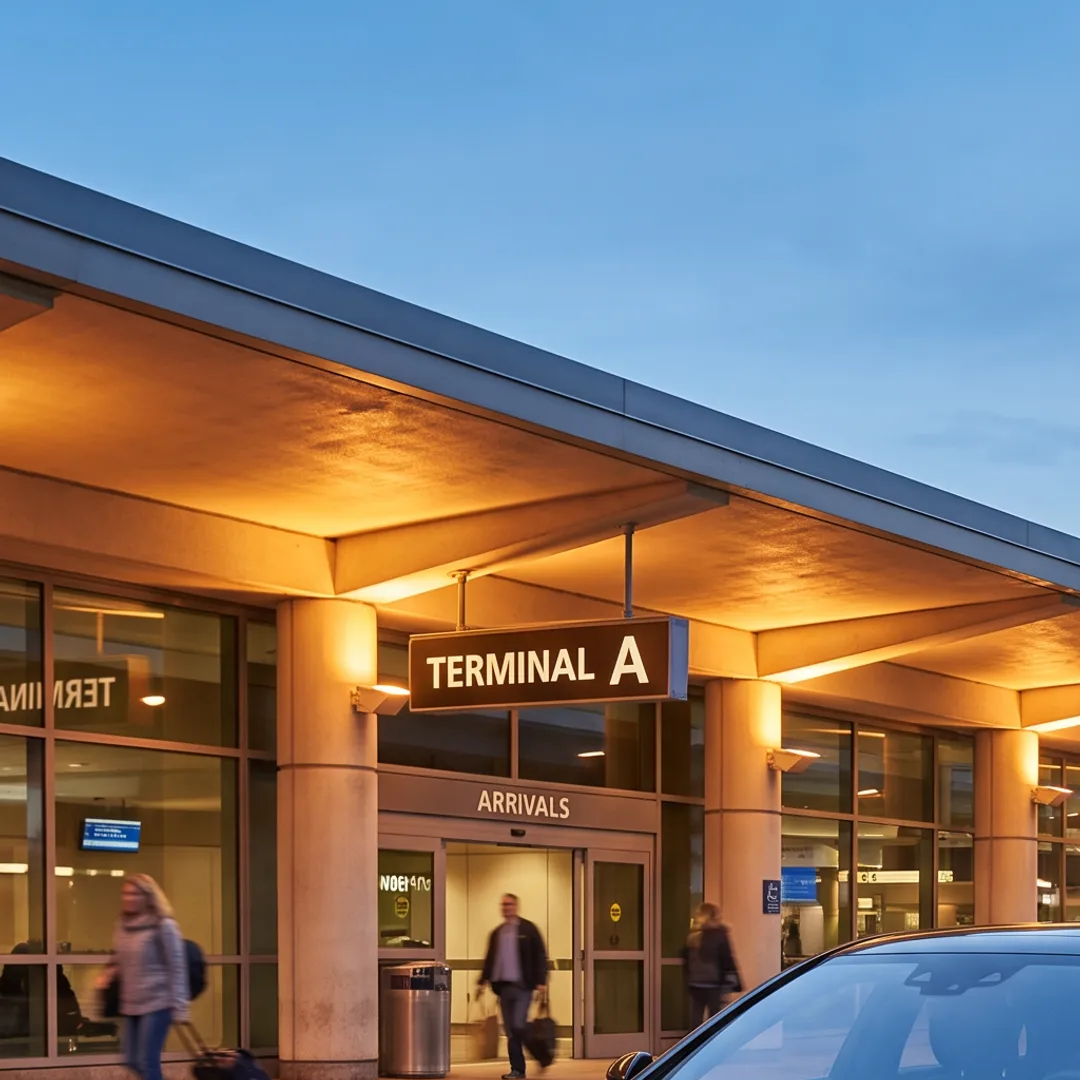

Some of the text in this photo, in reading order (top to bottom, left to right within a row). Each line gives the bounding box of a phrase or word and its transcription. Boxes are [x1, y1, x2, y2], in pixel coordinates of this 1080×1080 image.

[426, 635, 650, 690] TERMINAL A
[477, 790, 570, 819] ARRIVALS
